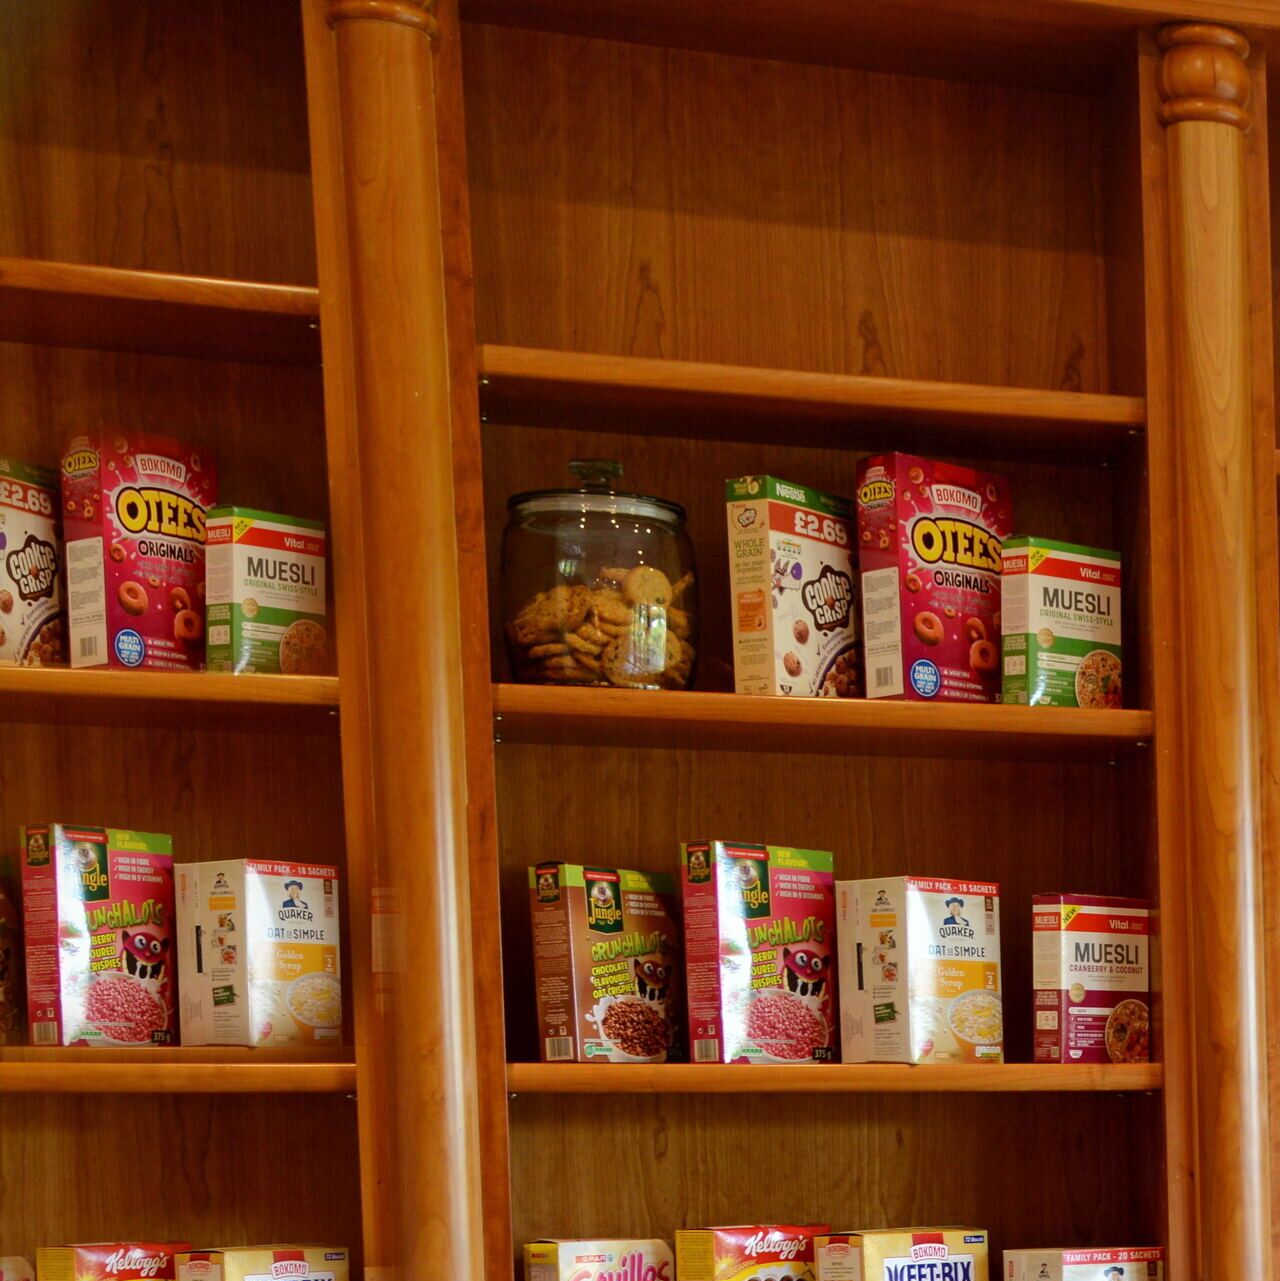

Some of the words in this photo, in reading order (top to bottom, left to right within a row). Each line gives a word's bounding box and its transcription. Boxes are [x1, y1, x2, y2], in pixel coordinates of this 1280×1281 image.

[141, 458, 182, 479] BOKOMO
[861, 482, 892, 503] OTEES
[936, 489, 978, 509] BOKOMO
[118, 489, 206, 540] OTEES
[208, 528, 230, 538] MUESLI
[794, 512, 847, 544] £2.69
[284, 537, 304, 548] Vital
[734, 539, 765, 549] WHOLE
[913, 518, 1002, 575] OTEES
[139, 541, 194, 563] ORIGINALS
[736, 548, 763, 558] GRAIN
[247, 557, 315, 585] MUESLI
[1003, 560, 1026, 569] MUESLI
[1080, 568, 1100, 579] Vital
[244, 579, 275, 589] ORIGINAL
[934, 571, 990, 593] ORIGINALS
[1043, 587, 1111, 616] MUESLI
[1040, 609, 1072, 620] ORIGINAL
[1074, 614, 1114, 626] SWISS-STYLE
[915, 673, 937, 682] GRAIN
[274, 866, 290, 874] PACK
[297, 867, 304, 876] 18
[305, 868, 336, 877] SACHETS
[910, 881, 934, 890] FAMILY
[935, 882, 952, 891] PACK
[959, 884, 967, 892] 18
[969, 884, 997, 894] SACHETS
[278, 909, 313, 922] QUAKER
[589, 897, 622, 925] Jungle
[1062, 906, 1077, 923] NEW
[1035, 916, 1059, 925] MUESLI
[1109, 919, 1128, 929] Vital
[268, 928, 286, 940] OAT
[293, 929, 324, 940] SIMPLE
[939, 926, 974, 940] QUAKER
[929, 944, 946, 956] OAT
[954, 945, 986, 958] SIMPLE
[1074, 943, 1139, 964] MUESLI
[326, 958, 333, 968] 2
[592, 962, 629, 976] CHOCOLATE
[1069, 964, 1107, 974] CRANBERRY
[1116, 966, 1142, 974] COCONUT
[938, 966, 965, 977] Golden
[593, 973, 631, 988] FLAVOURED
[987, 975, 993, 985] 2
[592, 988, 606, 999] OAT
[607, 985, 635, 997] CRISPIES
[745, 1232, 807, 1260] Kellogg's
[914, 1247, 946, 1259] BOKOMO
[1066, 1253, 1090, 1262] FAMILY
[1130, 1251, 1160, 1259] SACHETS
[106, 1248, 169, 1277] Kellogg's
[274, 1264, 307, 1276] BOKOMO
